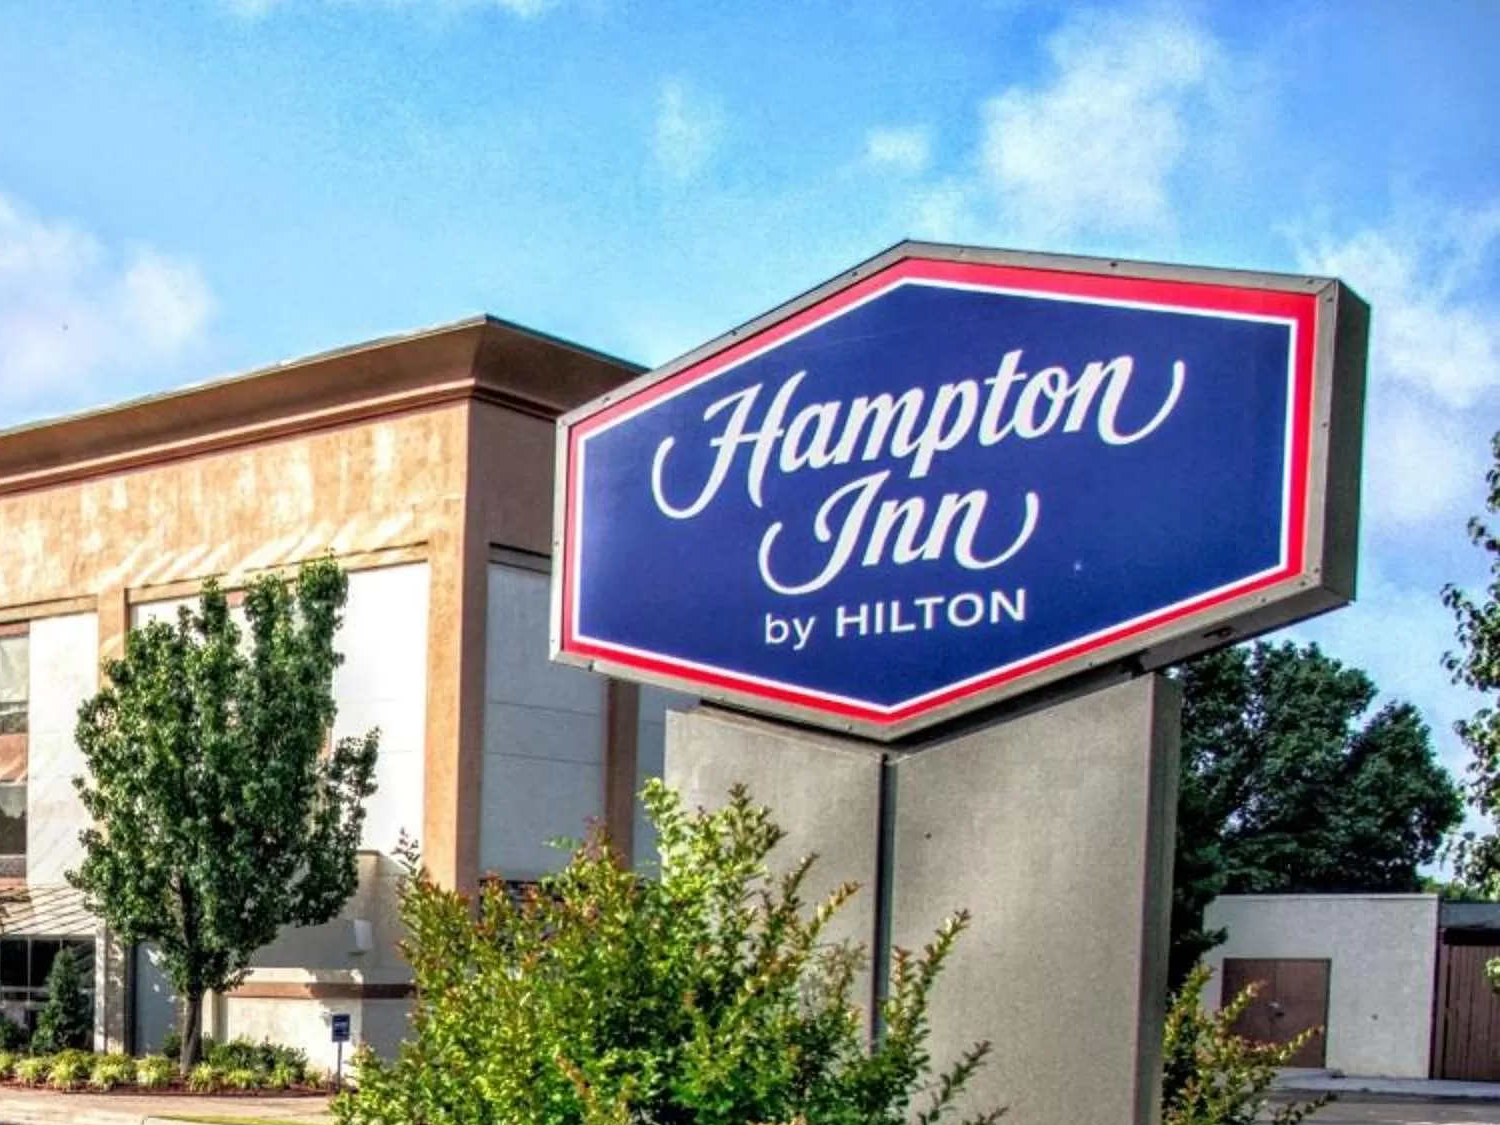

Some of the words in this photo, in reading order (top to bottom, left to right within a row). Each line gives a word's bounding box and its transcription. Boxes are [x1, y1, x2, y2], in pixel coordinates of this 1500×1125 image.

[651, 349, 1186, 520] Hampton
[758, 469, 1040, 595] Inn
[765, 612, 816, 650] by
[836, 588, 1026, 637] HILTON
